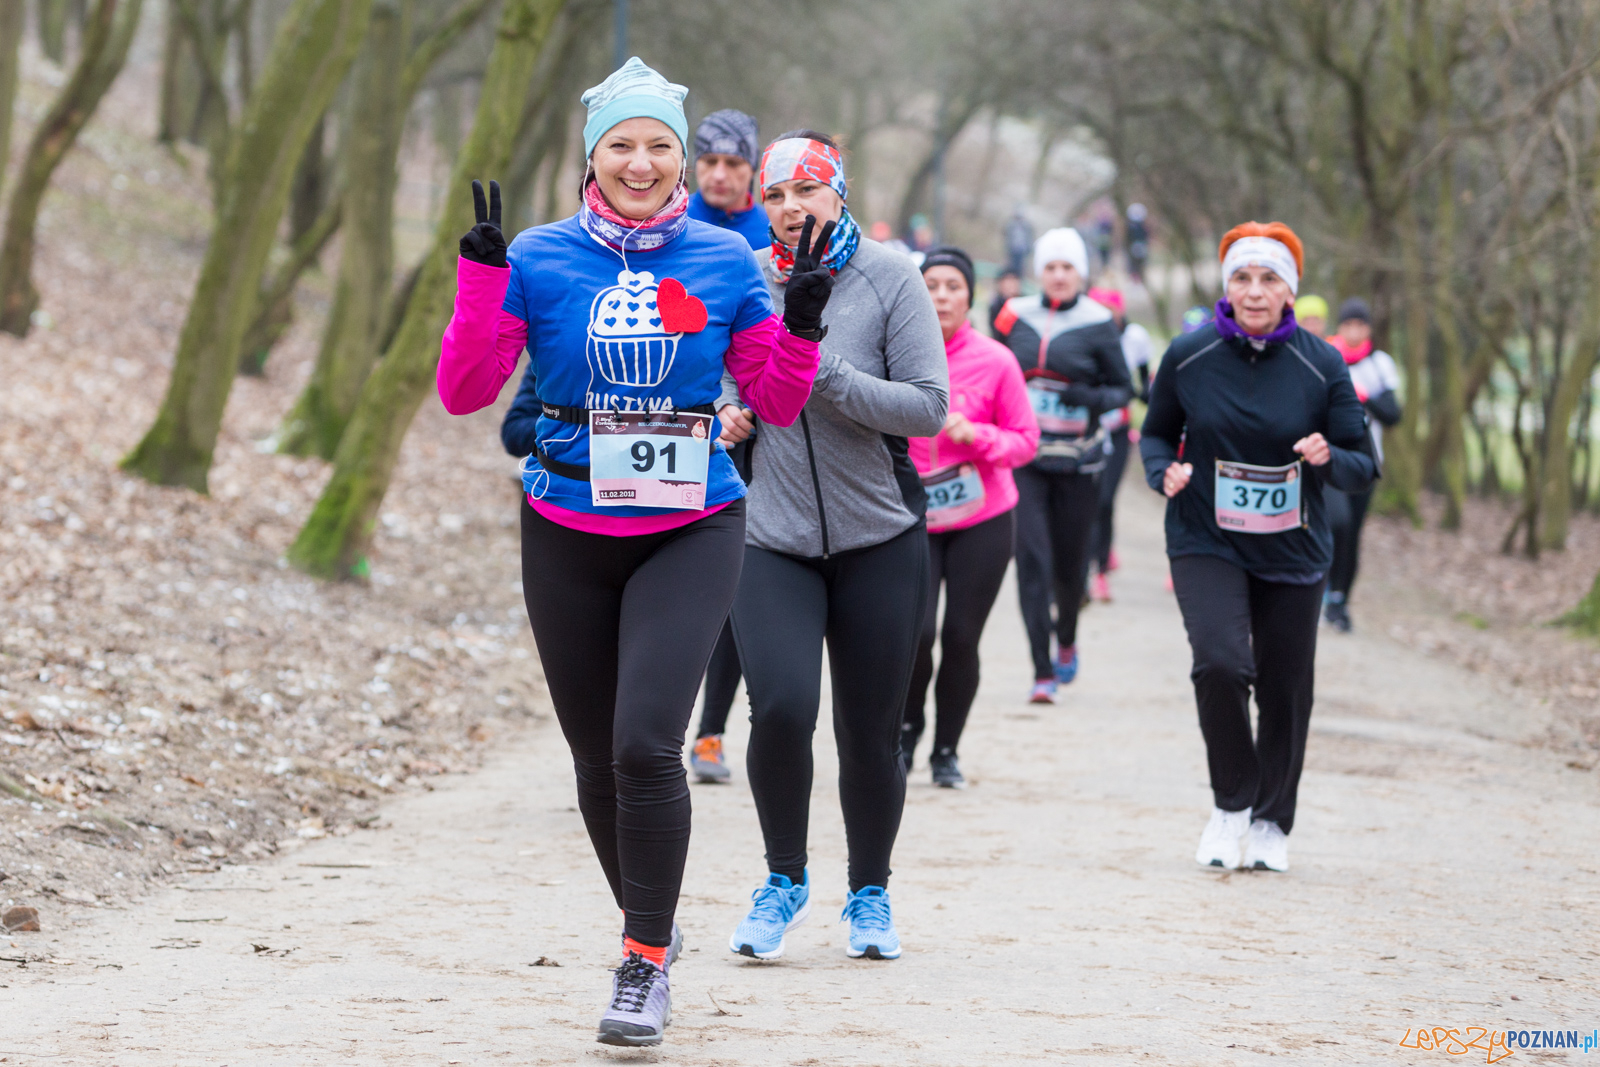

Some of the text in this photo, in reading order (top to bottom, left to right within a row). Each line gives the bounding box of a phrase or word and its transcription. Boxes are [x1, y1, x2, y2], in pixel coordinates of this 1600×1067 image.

[631, 440, 676, 474] 91
[600, 490, 635, 499] 11.02.2018
[1233, 485, 1286, 509] 370
